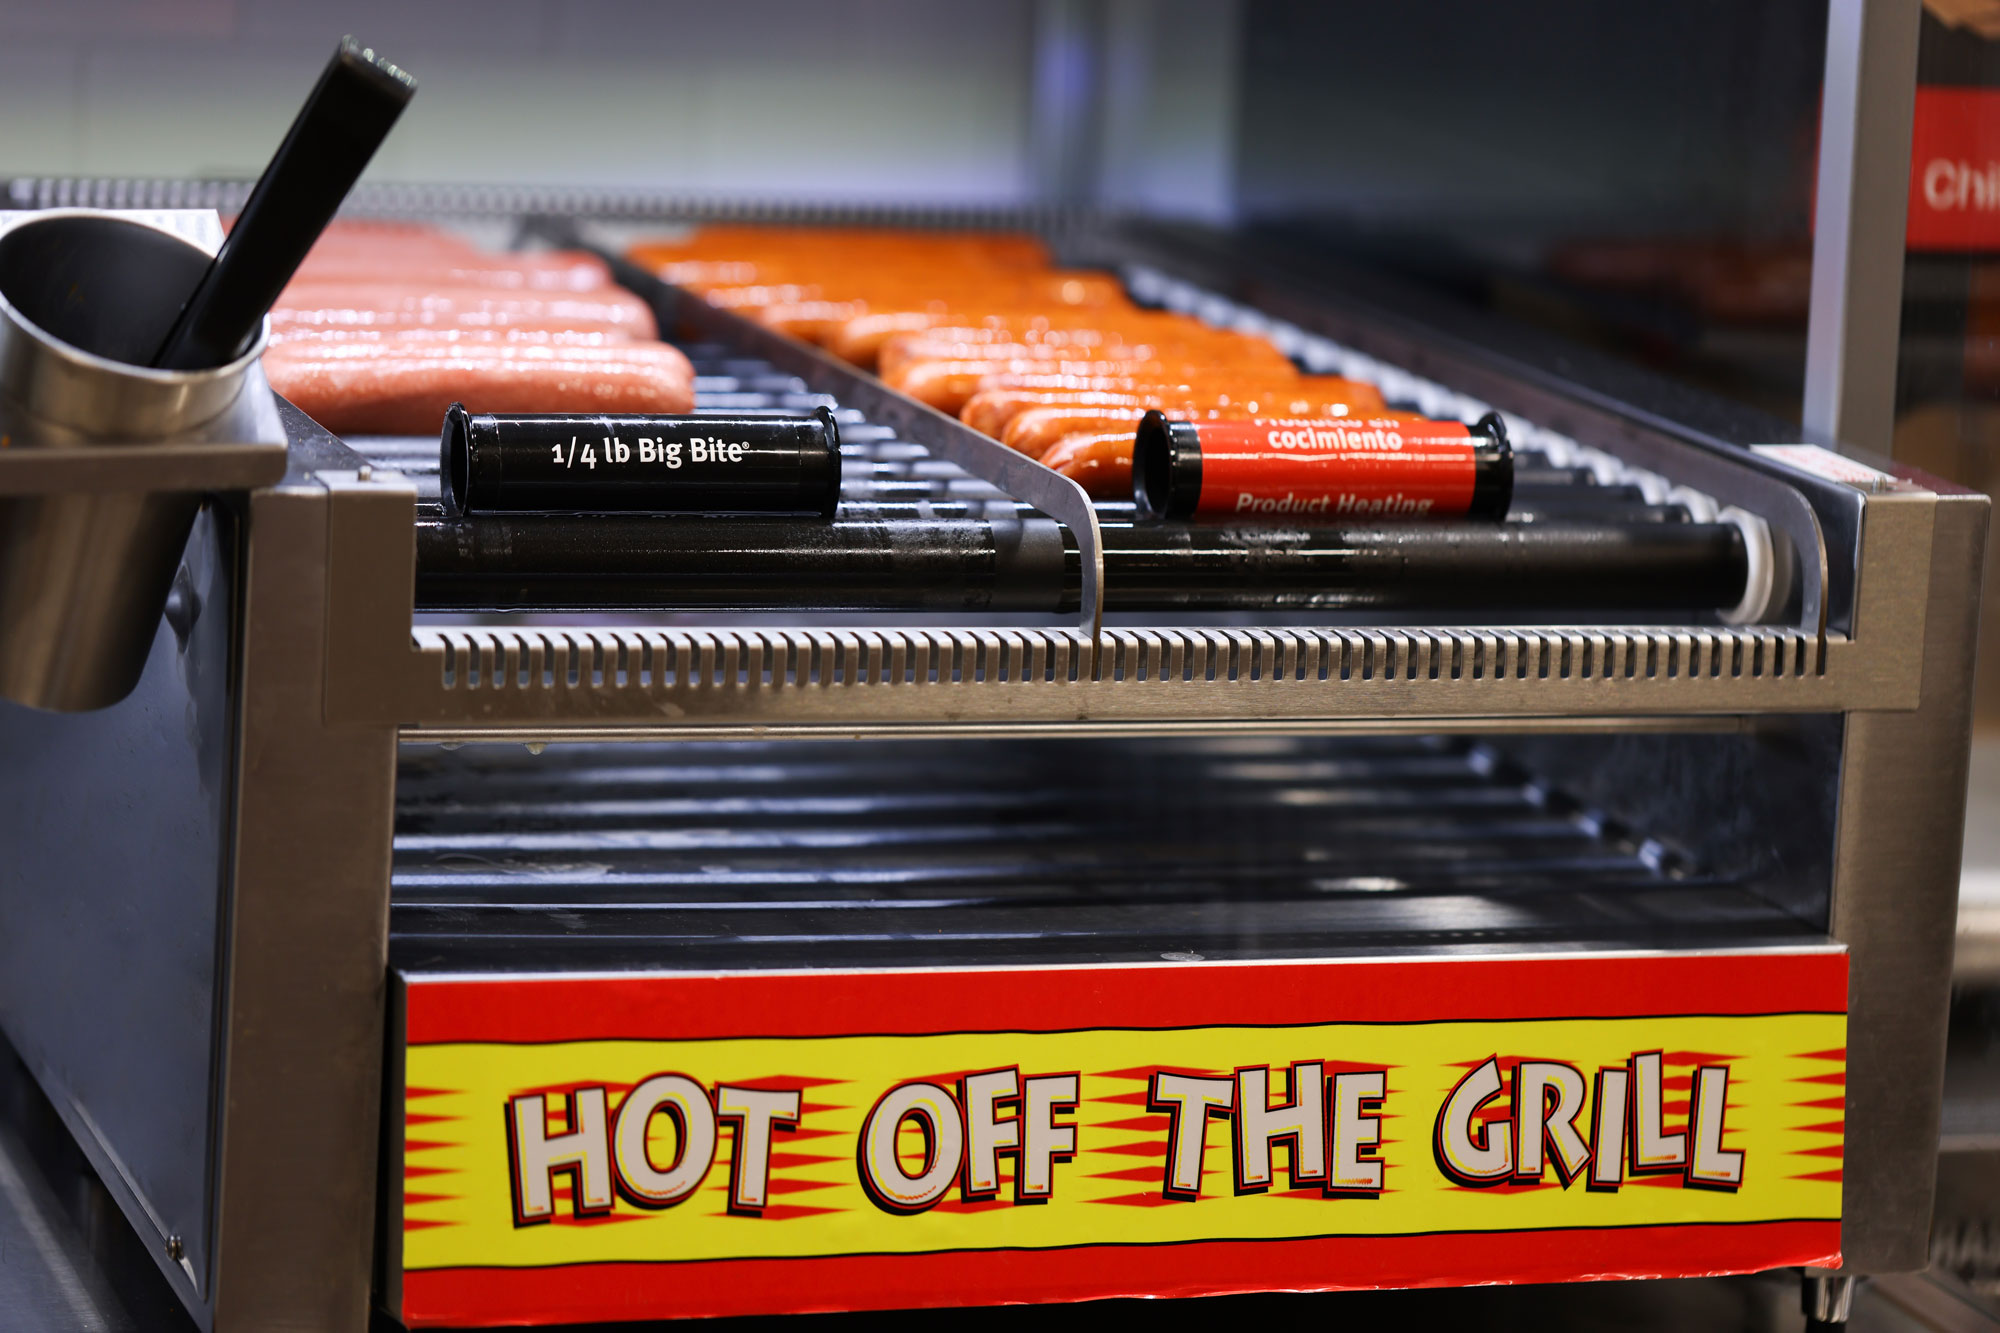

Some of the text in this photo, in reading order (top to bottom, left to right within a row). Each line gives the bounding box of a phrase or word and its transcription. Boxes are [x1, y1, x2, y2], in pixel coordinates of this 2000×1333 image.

[1925, 157, 2000, 212] Chi
[551, 436, 597, 470] 1/4
[603, 436, 631, 463] lb
[638, 436, 683, 469] Big
[1268, 427, 1403, 450] cocimiento
[1235, 492, 1434, 516] Product Heating
[504, 1048, 1745, 1229] HOT OFF THE GRILL
